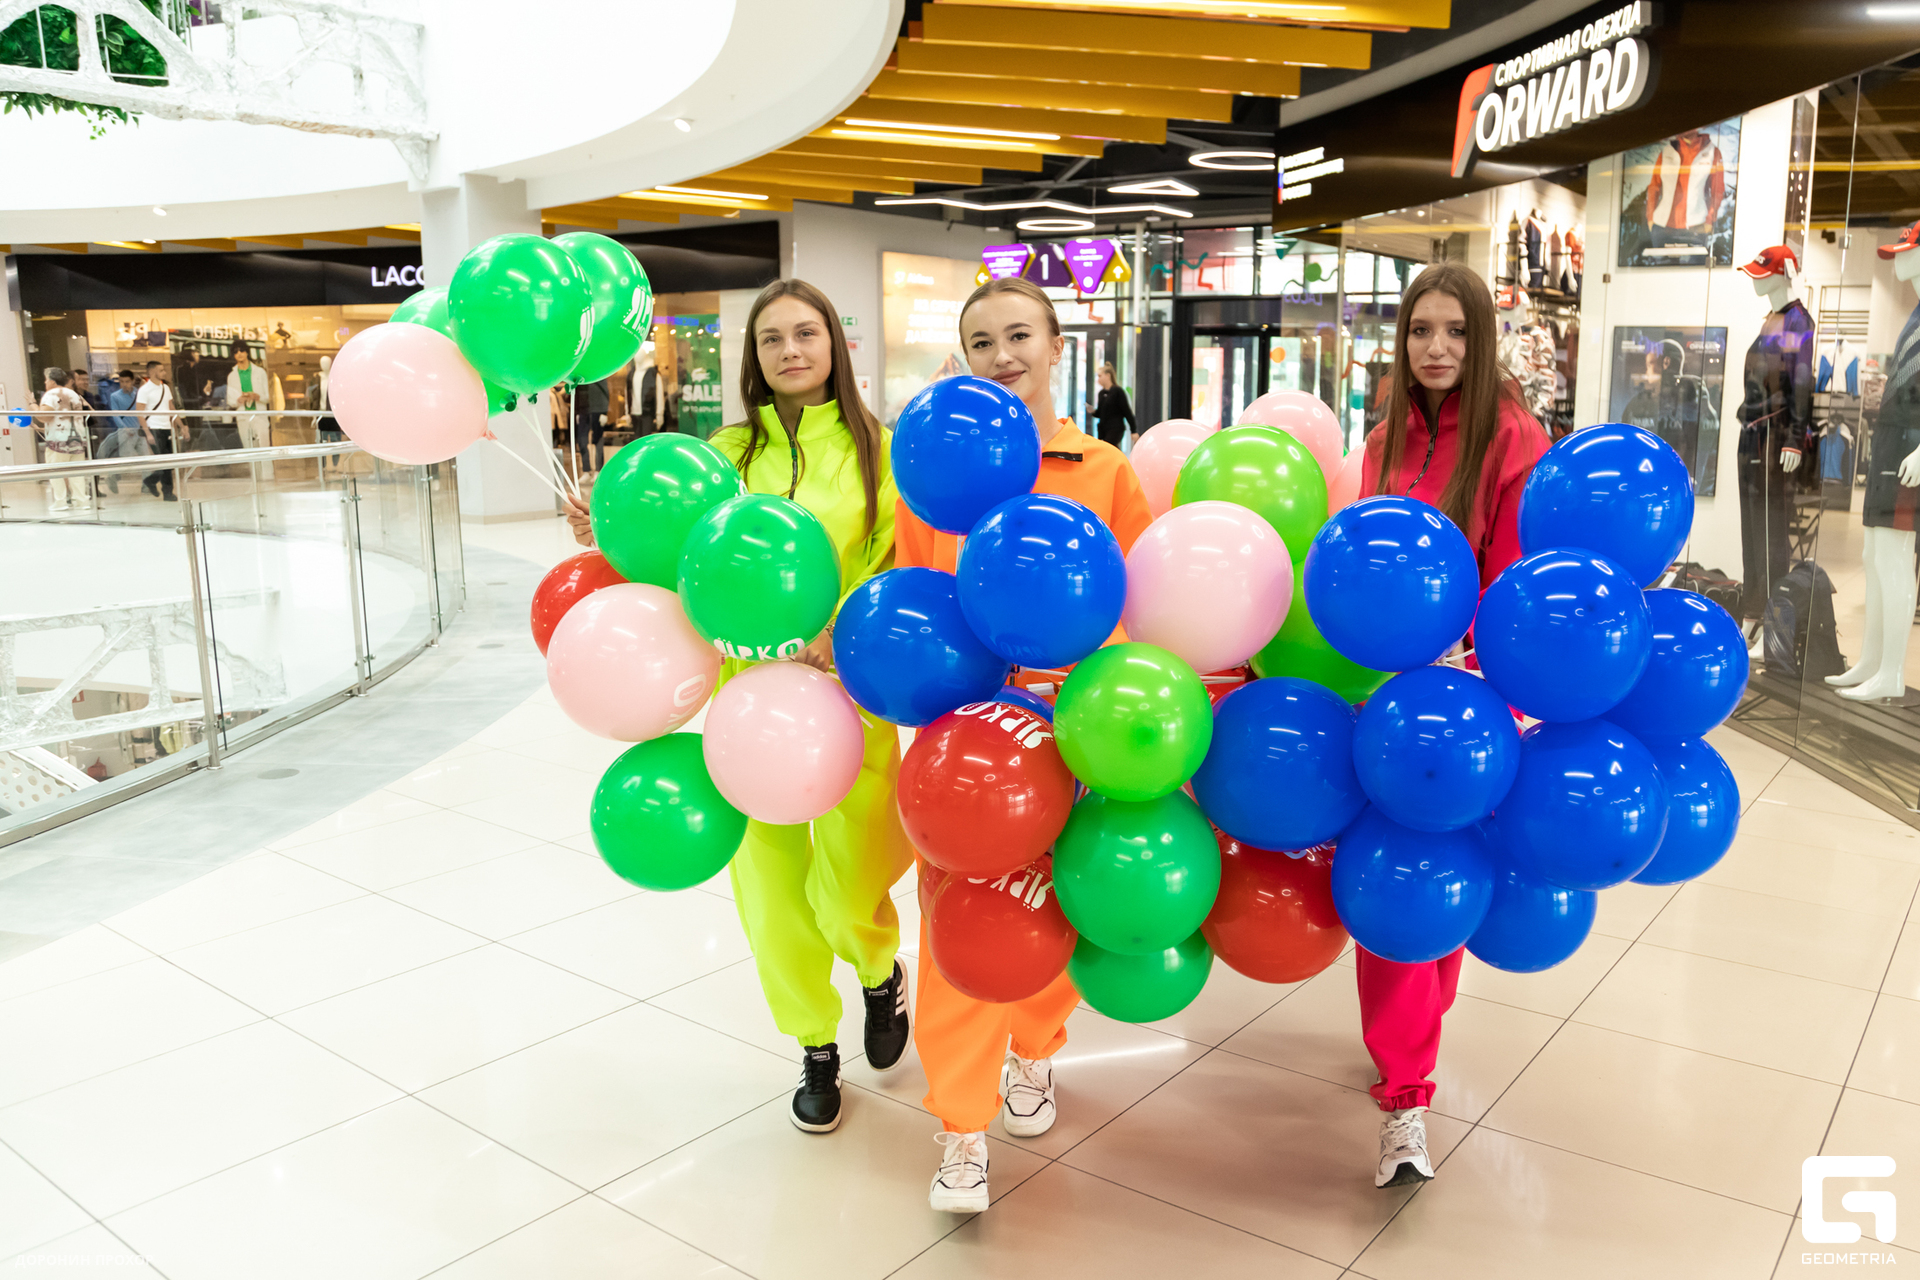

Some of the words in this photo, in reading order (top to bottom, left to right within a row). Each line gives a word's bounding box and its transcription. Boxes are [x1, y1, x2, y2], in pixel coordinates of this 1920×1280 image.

[1495, 29, 1584, 86] СПОРТИВНАЯ
[1581, 0, 1641, 50] ОДЕЖДА
[1451, 37, 1641, 177] FORWARD
[682, 385, 721, 402] SALE
